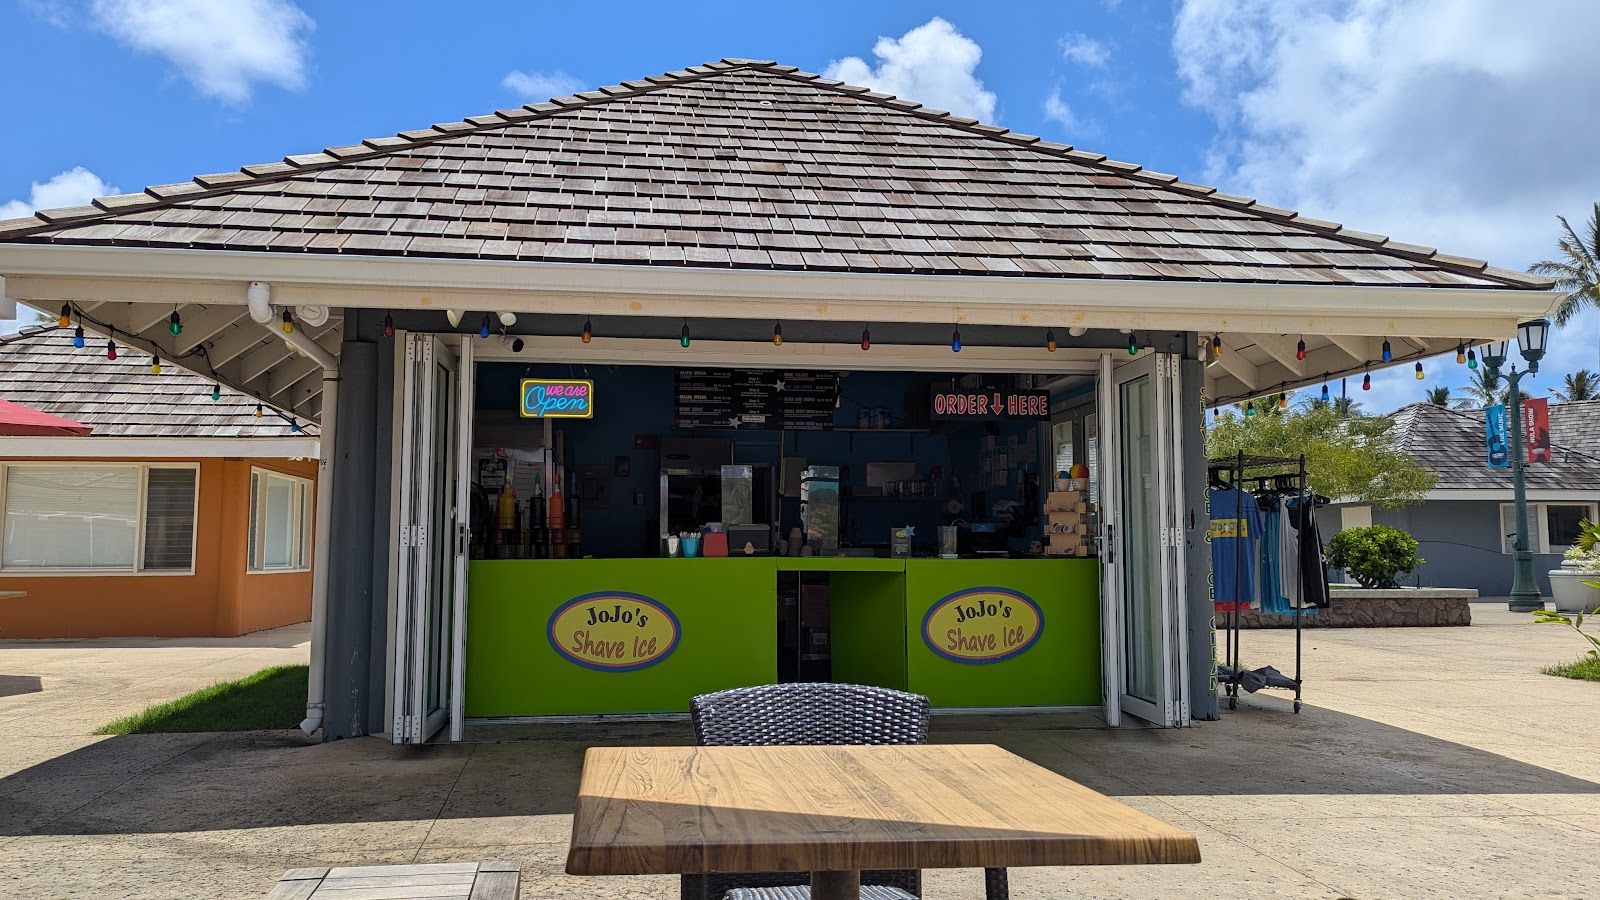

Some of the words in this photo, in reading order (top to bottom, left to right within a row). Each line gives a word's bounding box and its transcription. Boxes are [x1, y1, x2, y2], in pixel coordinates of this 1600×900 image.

[525, 386, 588, 416] Open
[546, 385, 564, 396] we
[565, 385, 588, 396] are
[934, 394, 988, 415] ORDER
[1007, 394, 1048, 416] HERE
[586, 605, 649, 628] JoJo's
[953, 600, 1012, 623] JoJo's
[571, 630, 625, 659] Shave
[632, 635, 657, 658] Ice
[946, 627, 997, 652] Shave
[1002, 625, 1024, 648] Ice
